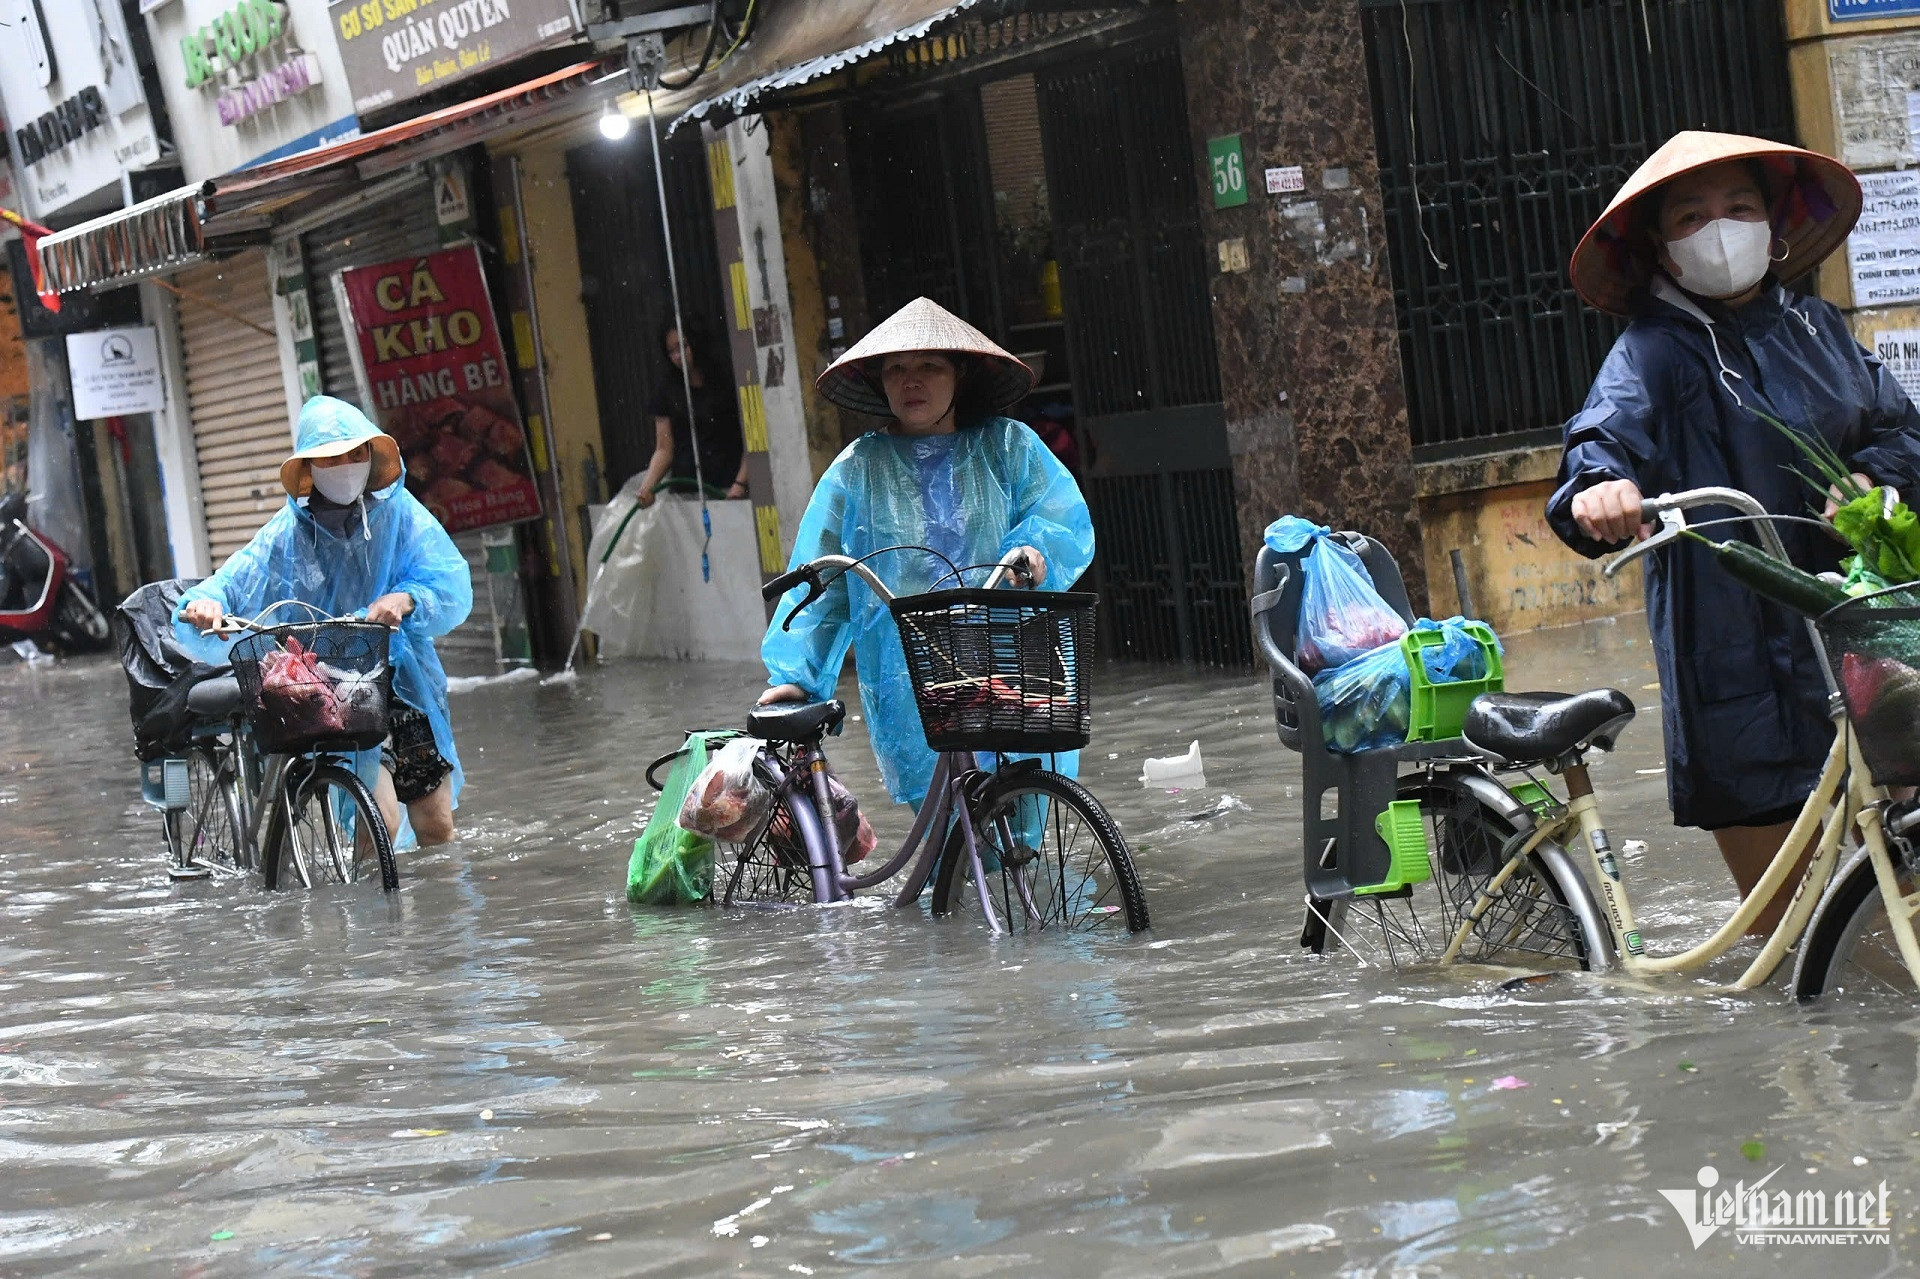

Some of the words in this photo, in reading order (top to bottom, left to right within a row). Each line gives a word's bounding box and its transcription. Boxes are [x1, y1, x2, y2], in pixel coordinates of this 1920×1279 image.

[382, 16, 438, 73] QUÂN
[1214, 152, 1242, 195] 56
[375, 257, 445, 312] CÁ
[371, 310, 482, 362] KHO
[1878, 334, 1900, 360] SỬA
[1903, 341, 1920, 360] NH
[377, 367, 456, 408] HÀNG
[463, 351, 502, 391] BÈ
